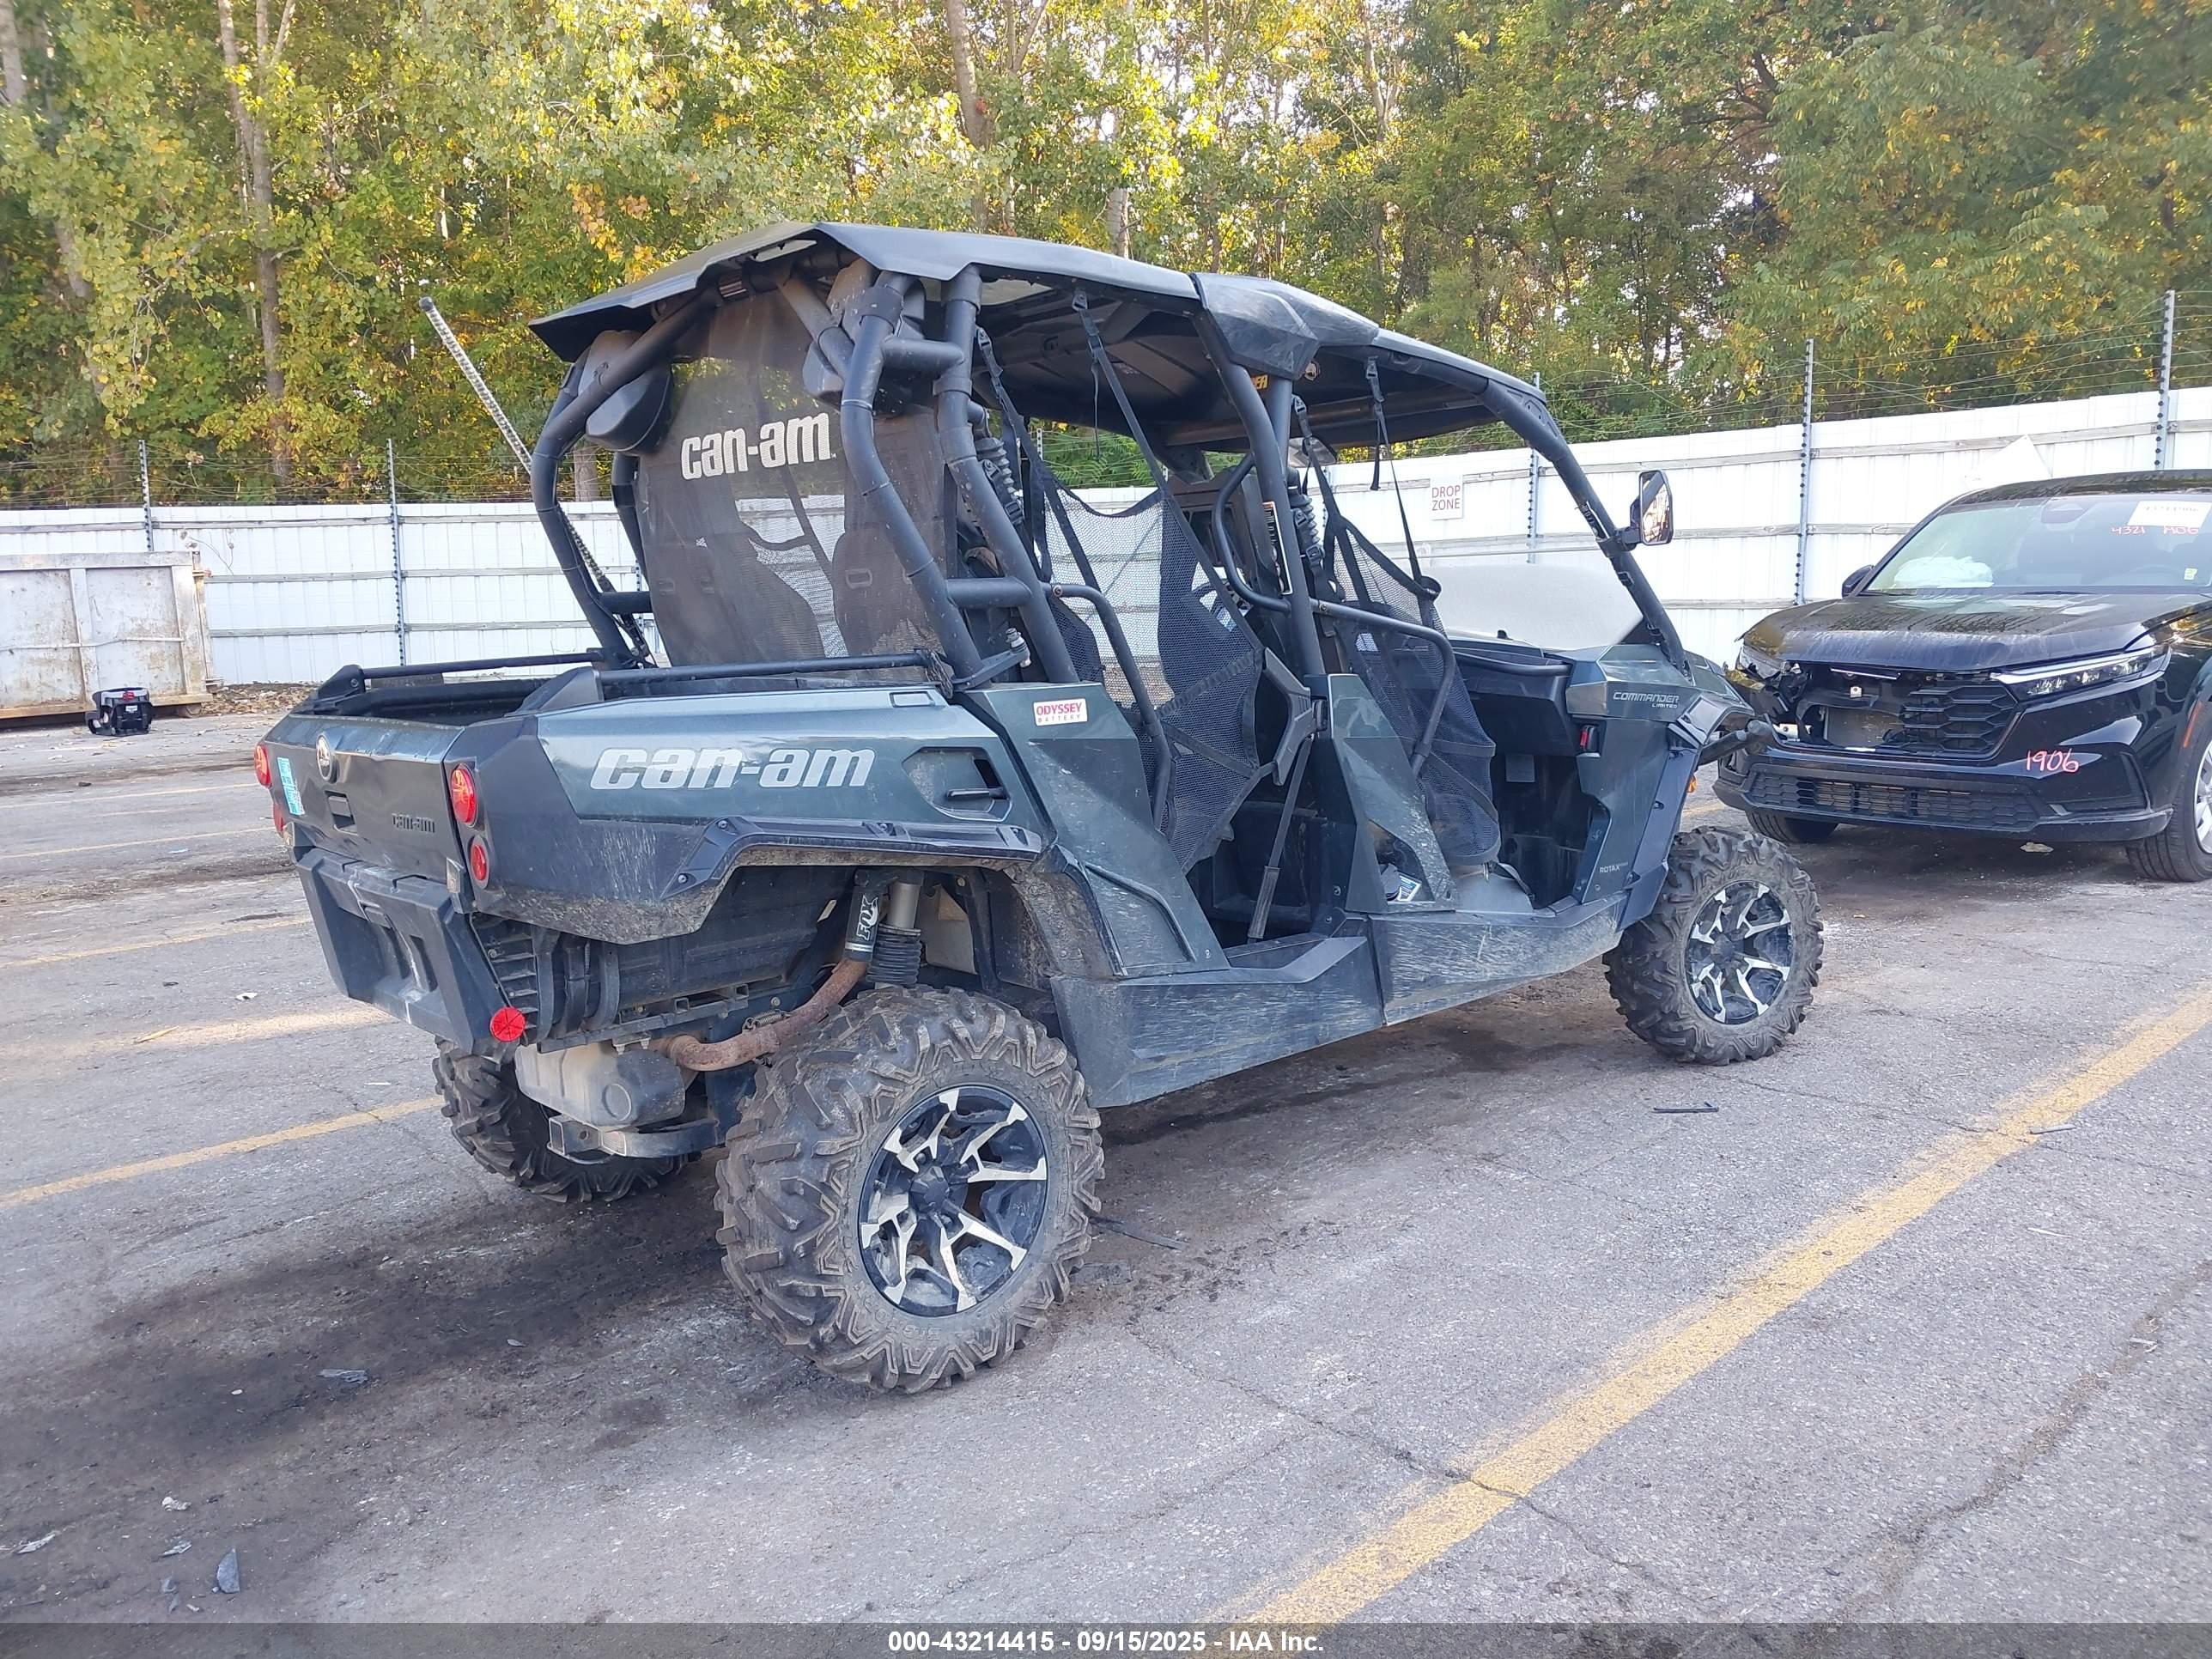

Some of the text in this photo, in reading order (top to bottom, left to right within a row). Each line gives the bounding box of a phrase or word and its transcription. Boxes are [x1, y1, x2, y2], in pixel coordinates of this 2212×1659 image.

[681, 412, 831, 480] can-am
[1431, 485, 1461, 498] DROP
[1431, 498, 1460, 511] ZONE
[1613, 691, 1680, 703] COMMANDER
[1036, 702, 1082, 717] ODYSSEY
[1037, 714, 1081, 724] BATTERY
[590, 747, 875, 789] can-am
[2026, 748, 2079, 773] 1906
[392, 812, 435, 834] can-am
[1599, 865, 1620, 873] ROTAX
[856, 894, 879, 941] FOX
